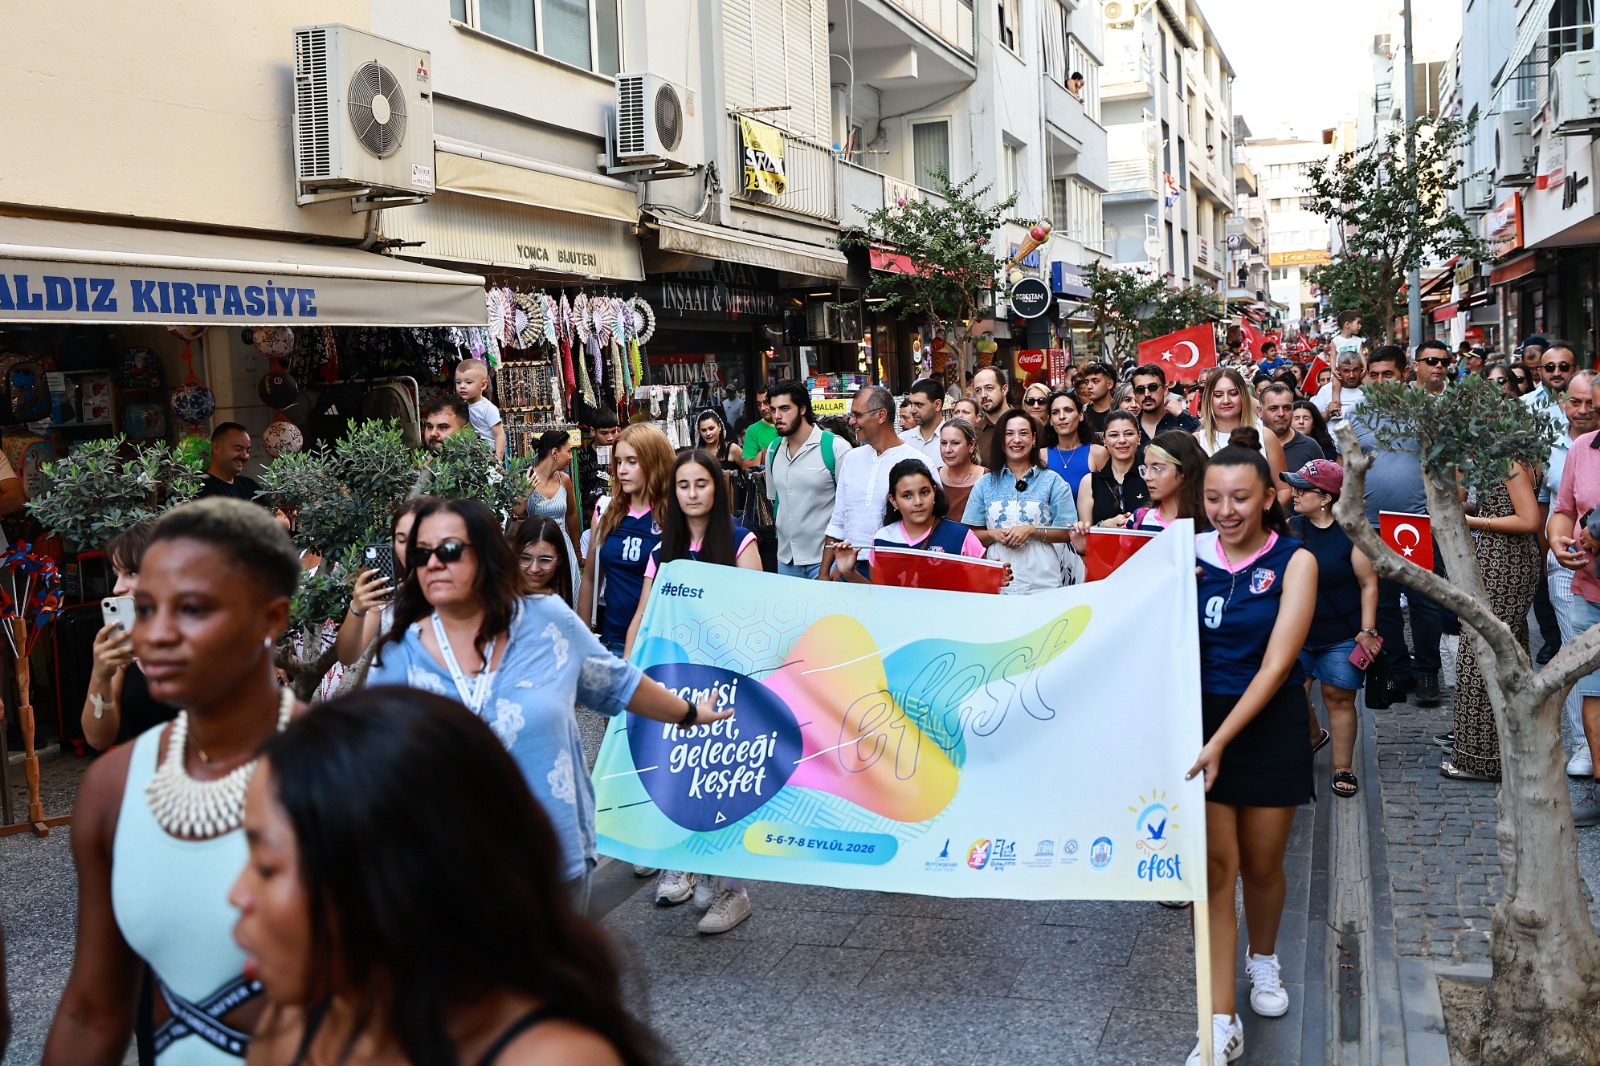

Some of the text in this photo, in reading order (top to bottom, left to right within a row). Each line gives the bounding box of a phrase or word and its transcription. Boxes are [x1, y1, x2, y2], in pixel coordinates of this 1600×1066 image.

[516, 245, 597, 267] YONCA BİJUTERİ
[130, 279, 318, 318] KIRTASİYE
[711, 285, 722, 312] &
[725, 287, 776, 316] MERMER
[663, 358, 720, 385] MİMAR
[622, 535, 643, 562] 18
[660, 582, 705, 600] #efest
[1204, 596, 1224, 629] 9
[656, 678, 738, 712] eçmişi
[837, 618, 1069, 781] efest
[662, 712, 740, 742] hsset,
[669, 731, 778, 773] geleceği
[688, 765, 767, 799] keşfet
[765, 834, 876, 855] 5-6-7-8 EYLÜL 2026
[1137, 853, 1182, 881] efest
